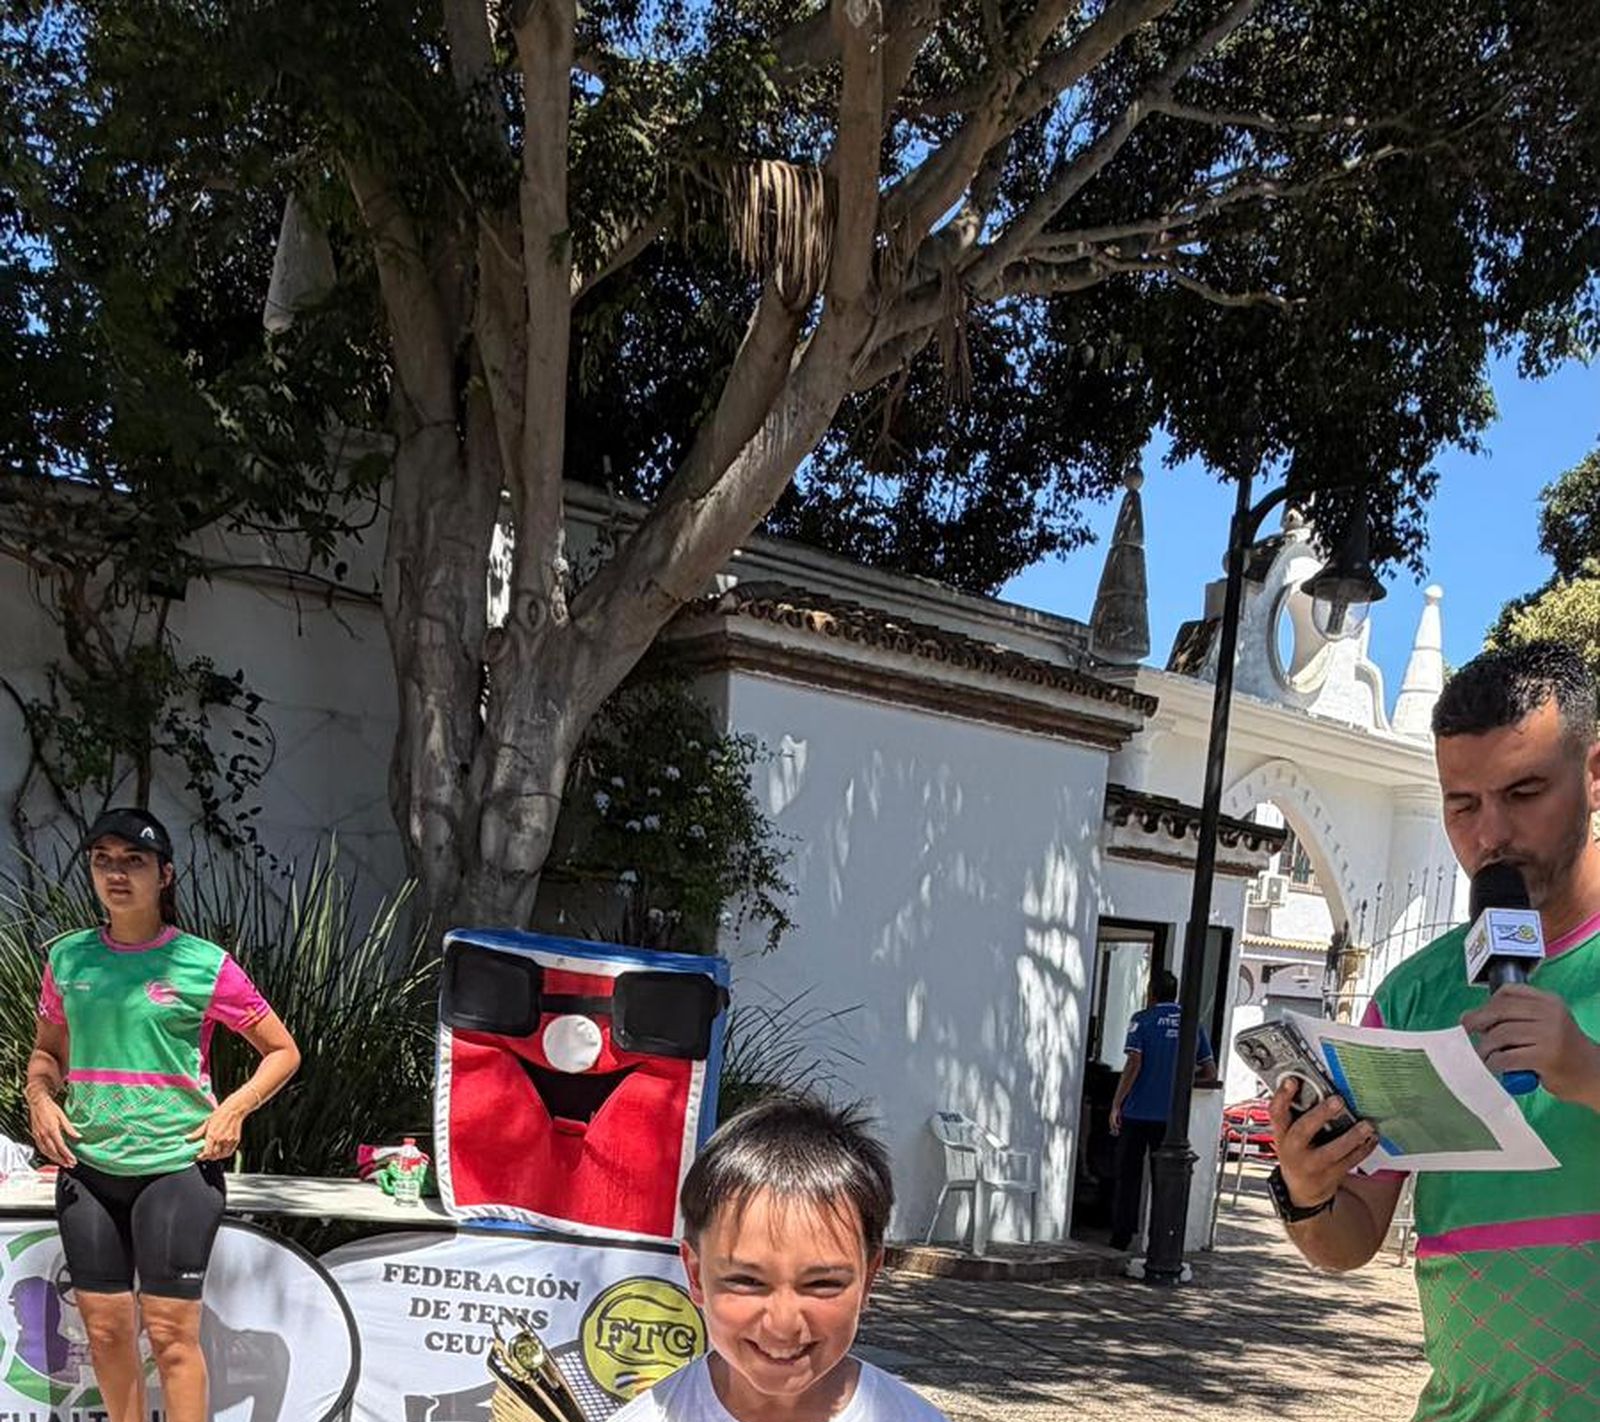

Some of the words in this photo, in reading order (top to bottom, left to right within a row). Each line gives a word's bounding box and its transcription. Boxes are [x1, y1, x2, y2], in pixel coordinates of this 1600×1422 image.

[383, 1263, 581, 1301] FEDERACIÓN
[409, 1297, 450, 1320] DE
[458, 1302, 549, 1330] TENIS
[424, 1331, 495, 1355] CEU
[595, 1316, 697, 1358] FTC
